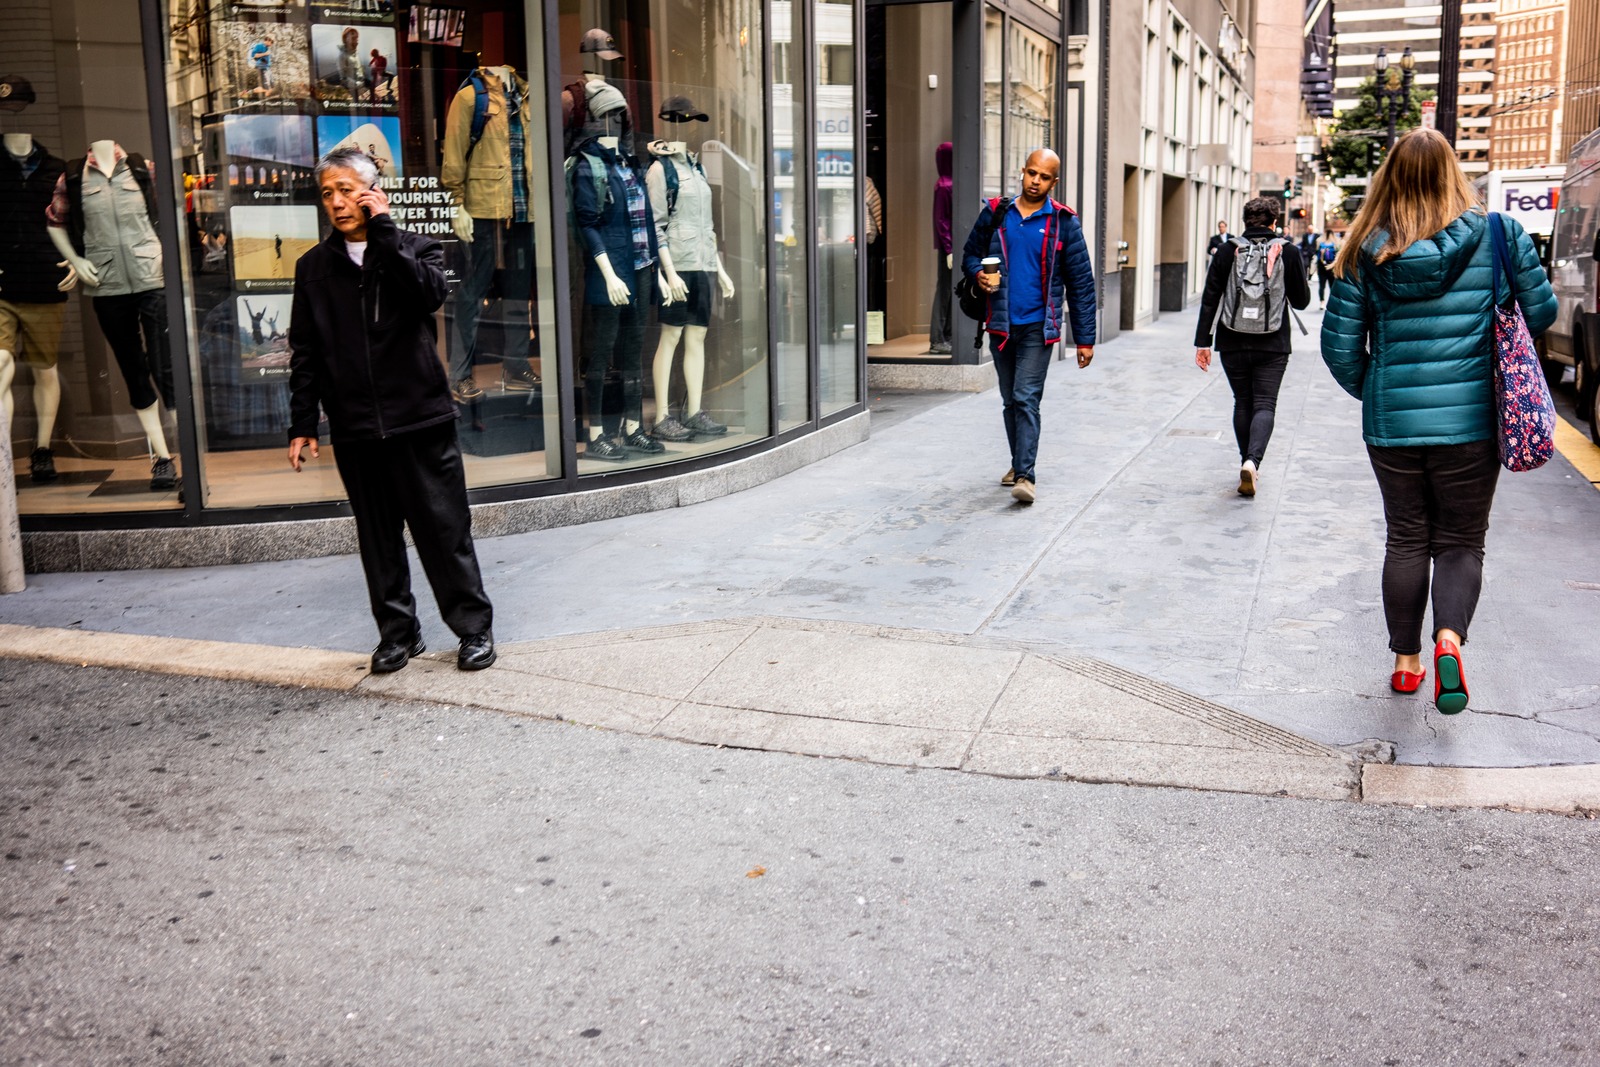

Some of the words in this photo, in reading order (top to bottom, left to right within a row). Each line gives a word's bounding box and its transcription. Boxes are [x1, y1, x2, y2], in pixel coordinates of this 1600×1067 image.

[379, 177, 405, 189] UILT
[409, 176, 438, 189] FOR
[387, 192, 455, 204] JOURNEY,
[390, 207, 426, 220] EVER
[430, 206, 459, 219] THE
[396, 222, 454, 234] NATION.
